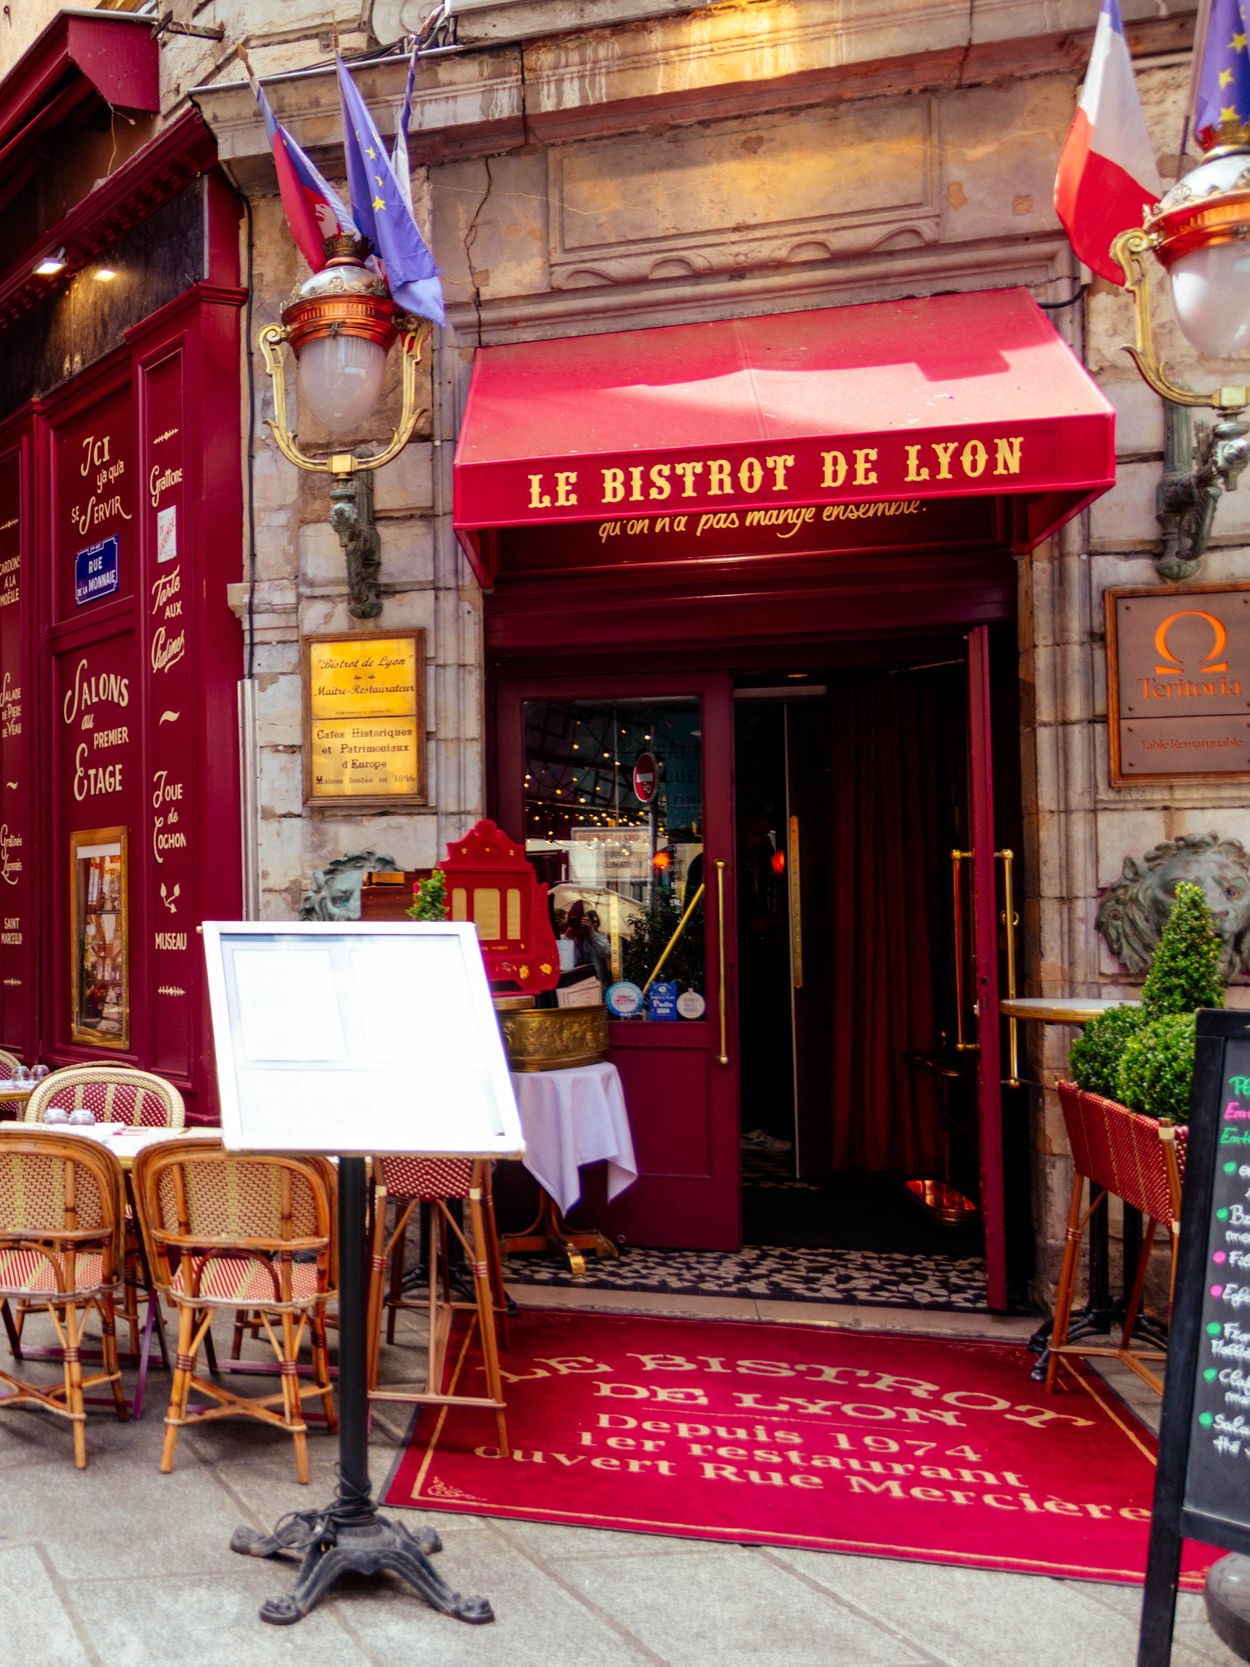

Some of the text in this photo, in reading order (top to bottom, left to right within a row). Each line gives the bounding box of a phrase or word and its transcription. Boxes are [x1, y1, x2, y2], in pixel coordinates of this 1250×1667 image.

[527, 436, 1024, 510] LE BISTROT DE LYON
[71, 495, 132, 535] SE SERVIR
[696, 511, 739, 536] pas
[88, 556, 103, 574] RUE
[77, 569, 116, 597] DE LA MONNAIE
[164, 600, 183, 620] AUX
[361, 657, 375, 667] de
[63, 658, 130, 725] SALONS
[1138, 676, 1242, 700] Teritoria
[81, 711, 94, 731] au
[93, 726, 129, 750] PREMIER
[352, 728, 413, 740] Historiques
[1140, 737, 1242, 751] Table Remarquable
[321, 744, 410, 754] et Patrimoniaux
[73, 742, 123, 802] ETAGE
[342, 758, 387, 770] d'Europe
[152, 770, 184, 809] JOUE
[167, 808, 179, 826] de
[153, 815, 187, 864] COCHON
[4, 918, 20, 930] SAINT
[154, 932, 187, 951] MUSEAU
[476, 1353, 1097, 1429] LE BISTROT
[593, 1381, 967, 1427] DE LYON
[596, 1413, 982, 1462] Depuis 1974
[688, 1443, 1030, 1488] restaurant
[474, 1446, 1152, 1523] ouvert Rue Mercière
